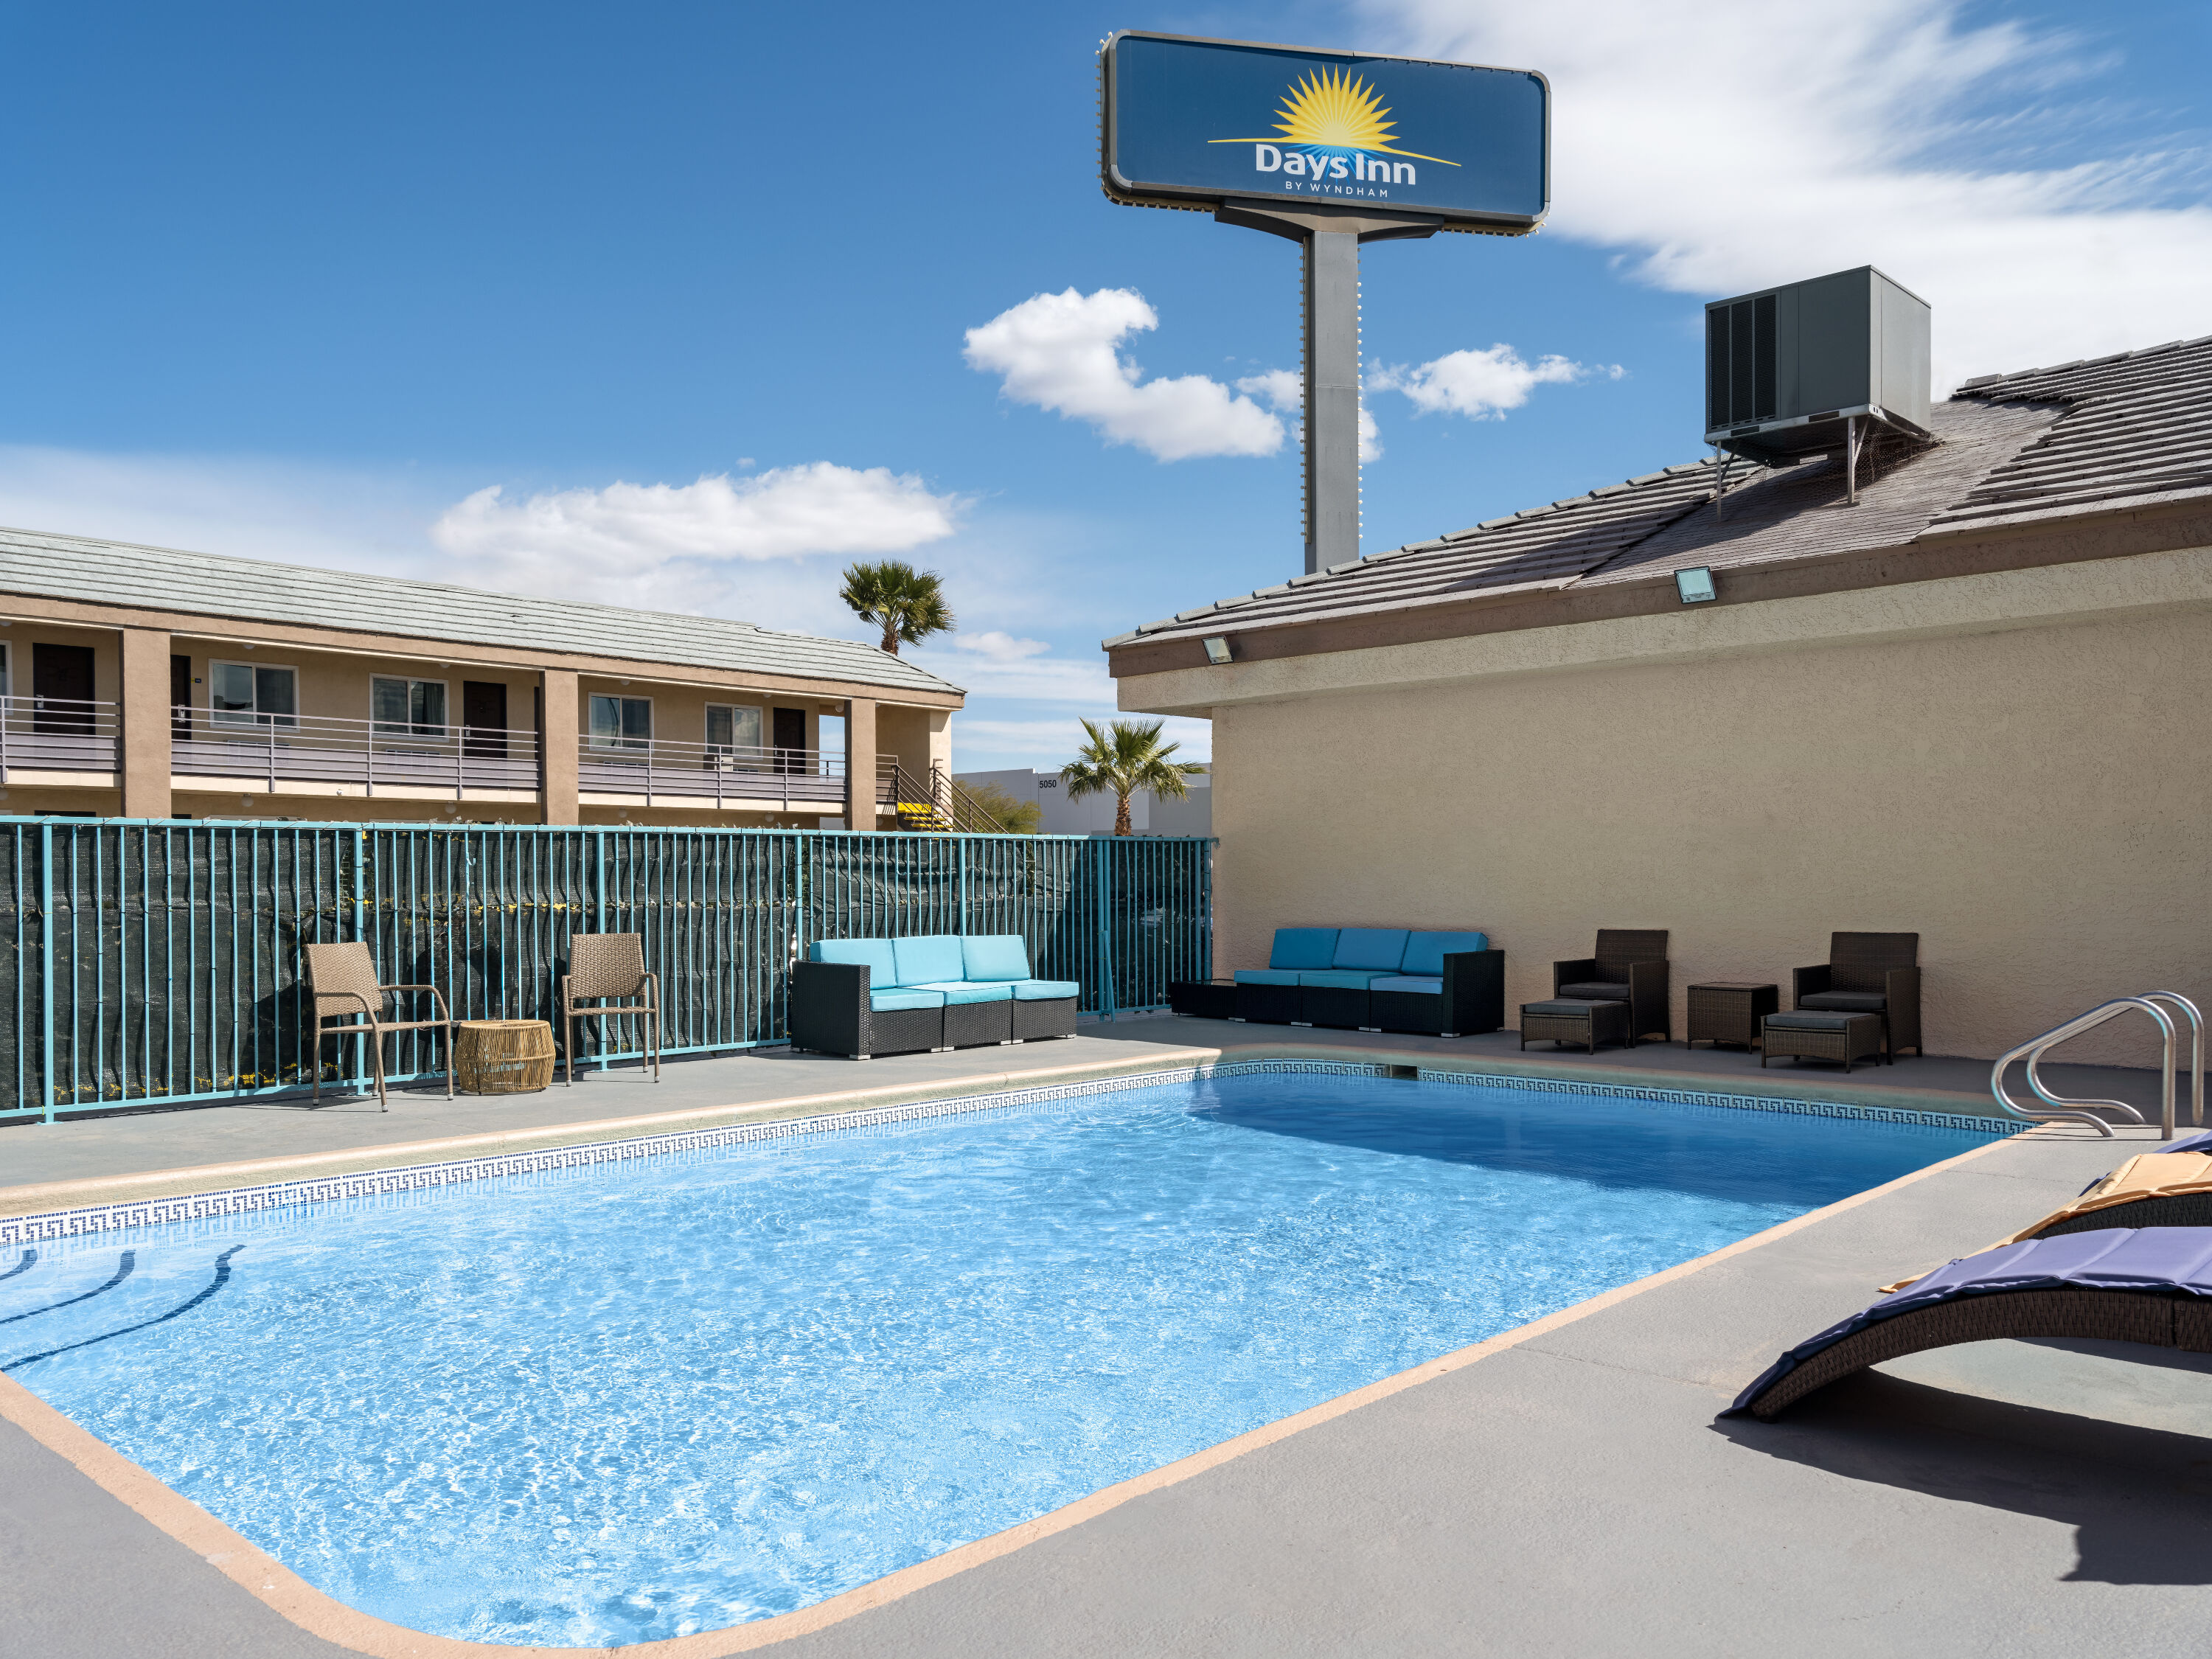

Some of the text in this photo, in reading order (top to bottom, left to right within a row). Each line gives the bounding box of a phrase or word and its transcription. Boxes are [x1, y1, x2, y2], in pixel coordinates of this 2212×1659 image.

[1256, 143, 1416, 185] Days Inn
[1285, 181, 1388, 198] BY WYNDHAM
[1039, 779, 1057, 788] 5050
